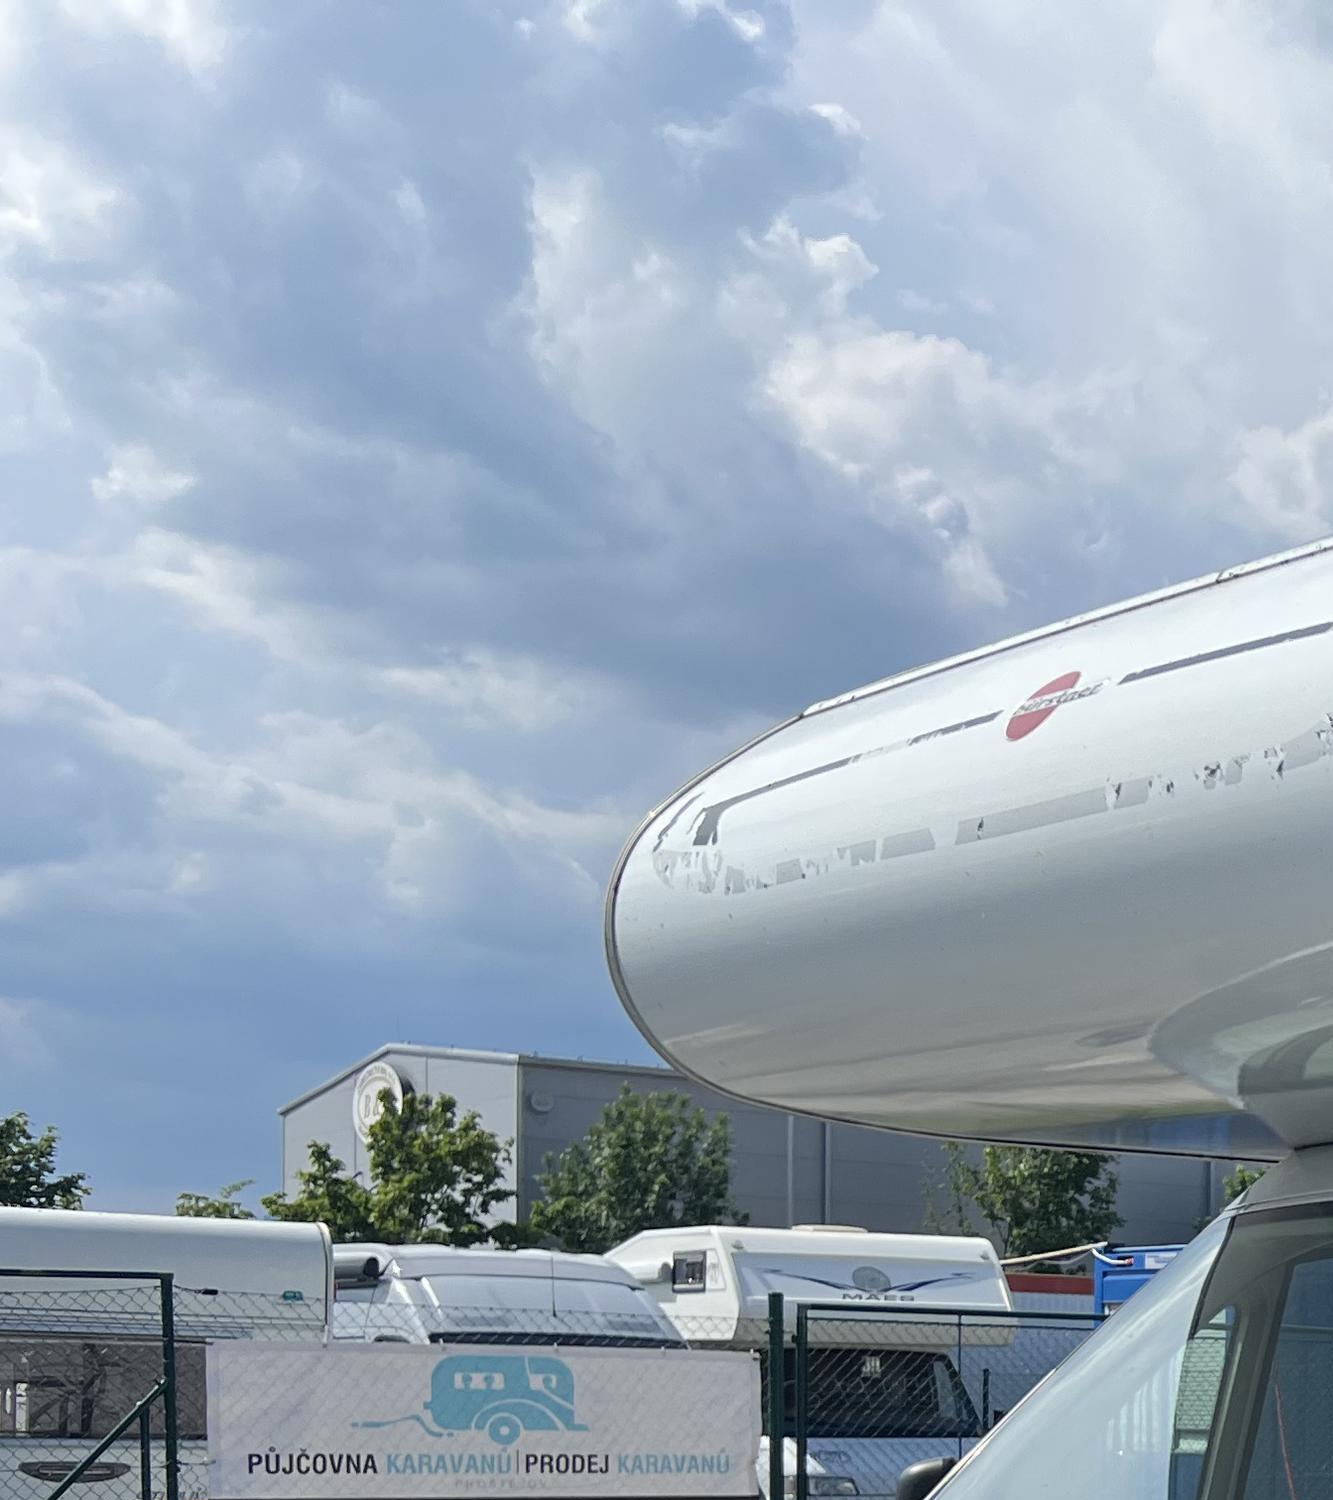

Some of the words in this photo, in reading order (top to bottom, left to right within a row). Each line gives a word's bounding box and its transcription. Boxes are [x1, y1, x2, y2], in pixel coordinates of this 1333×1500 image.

[248, 1446, 378, 1475] PŮJČOVNA
[387, 1447, 512, 1475] KARAVANŮ
[525, 1453, 609, 1474] PRODEJ
[617, 1448, 730, 1474] KARAVANŮ
